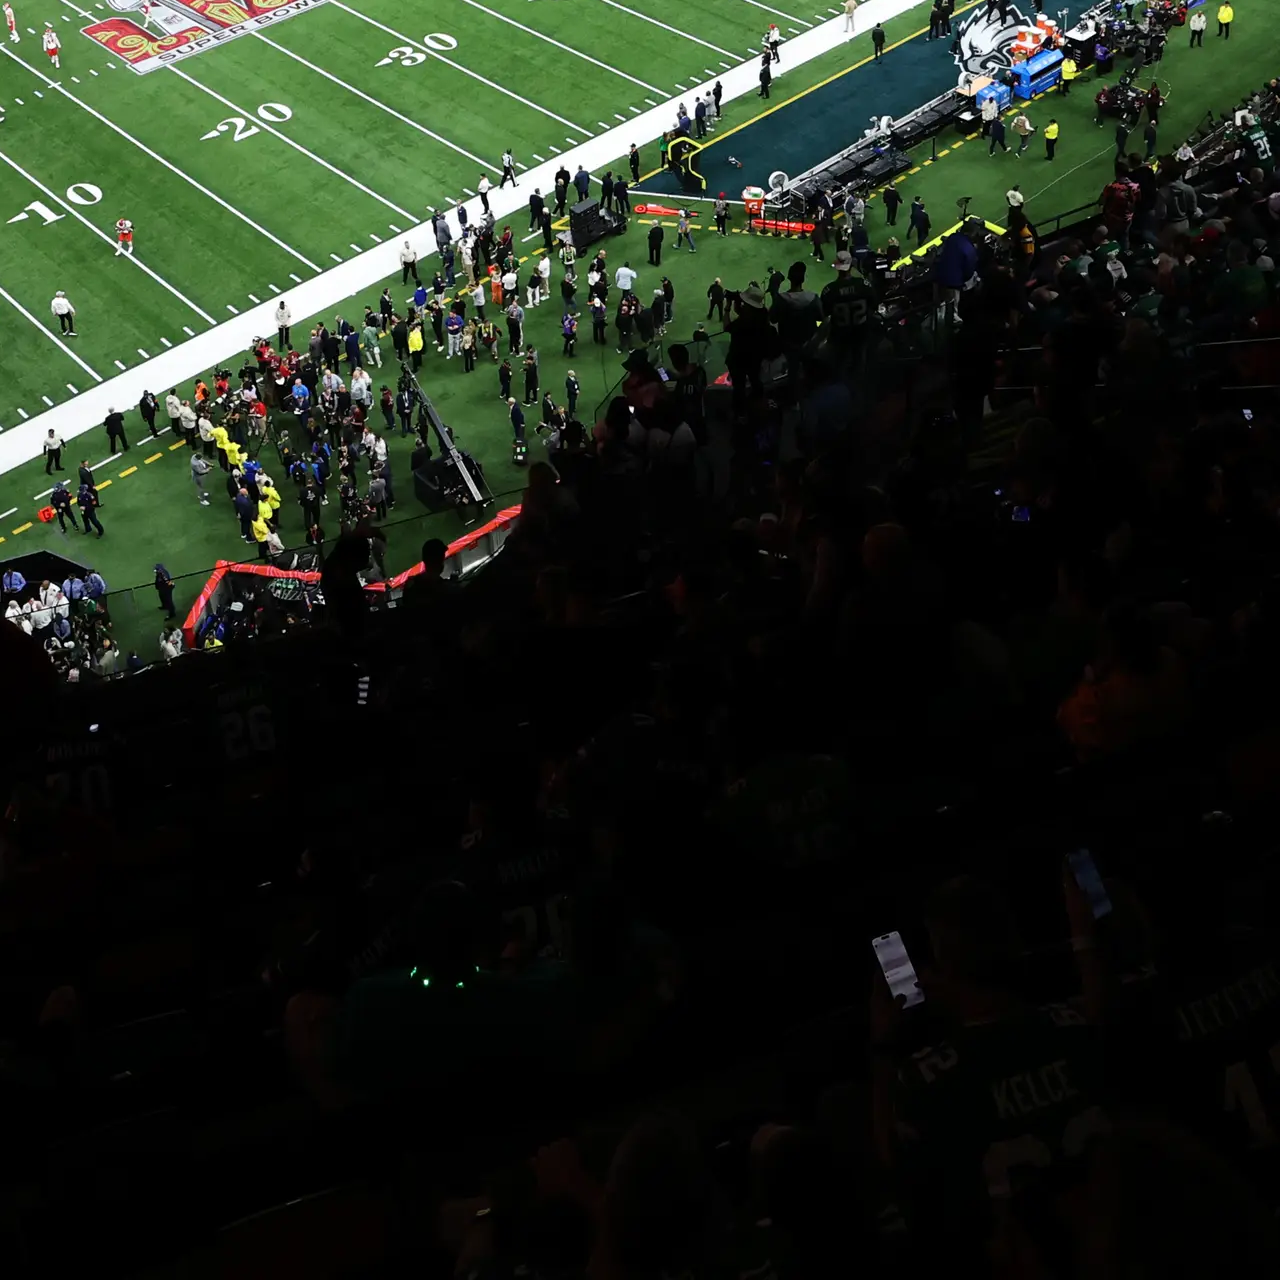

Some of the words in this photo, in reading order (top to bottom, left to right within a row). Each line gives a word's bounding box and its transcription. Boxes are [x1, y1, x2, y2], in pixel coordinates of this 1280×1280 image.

[158, 24, 247, 62] SUPER
[389, 33, 457, 66] 30
[216, 103, 292, 141] 20
[22, 183, 99, 226] 10
[991, 1059, 1078, 1119] KELCE
